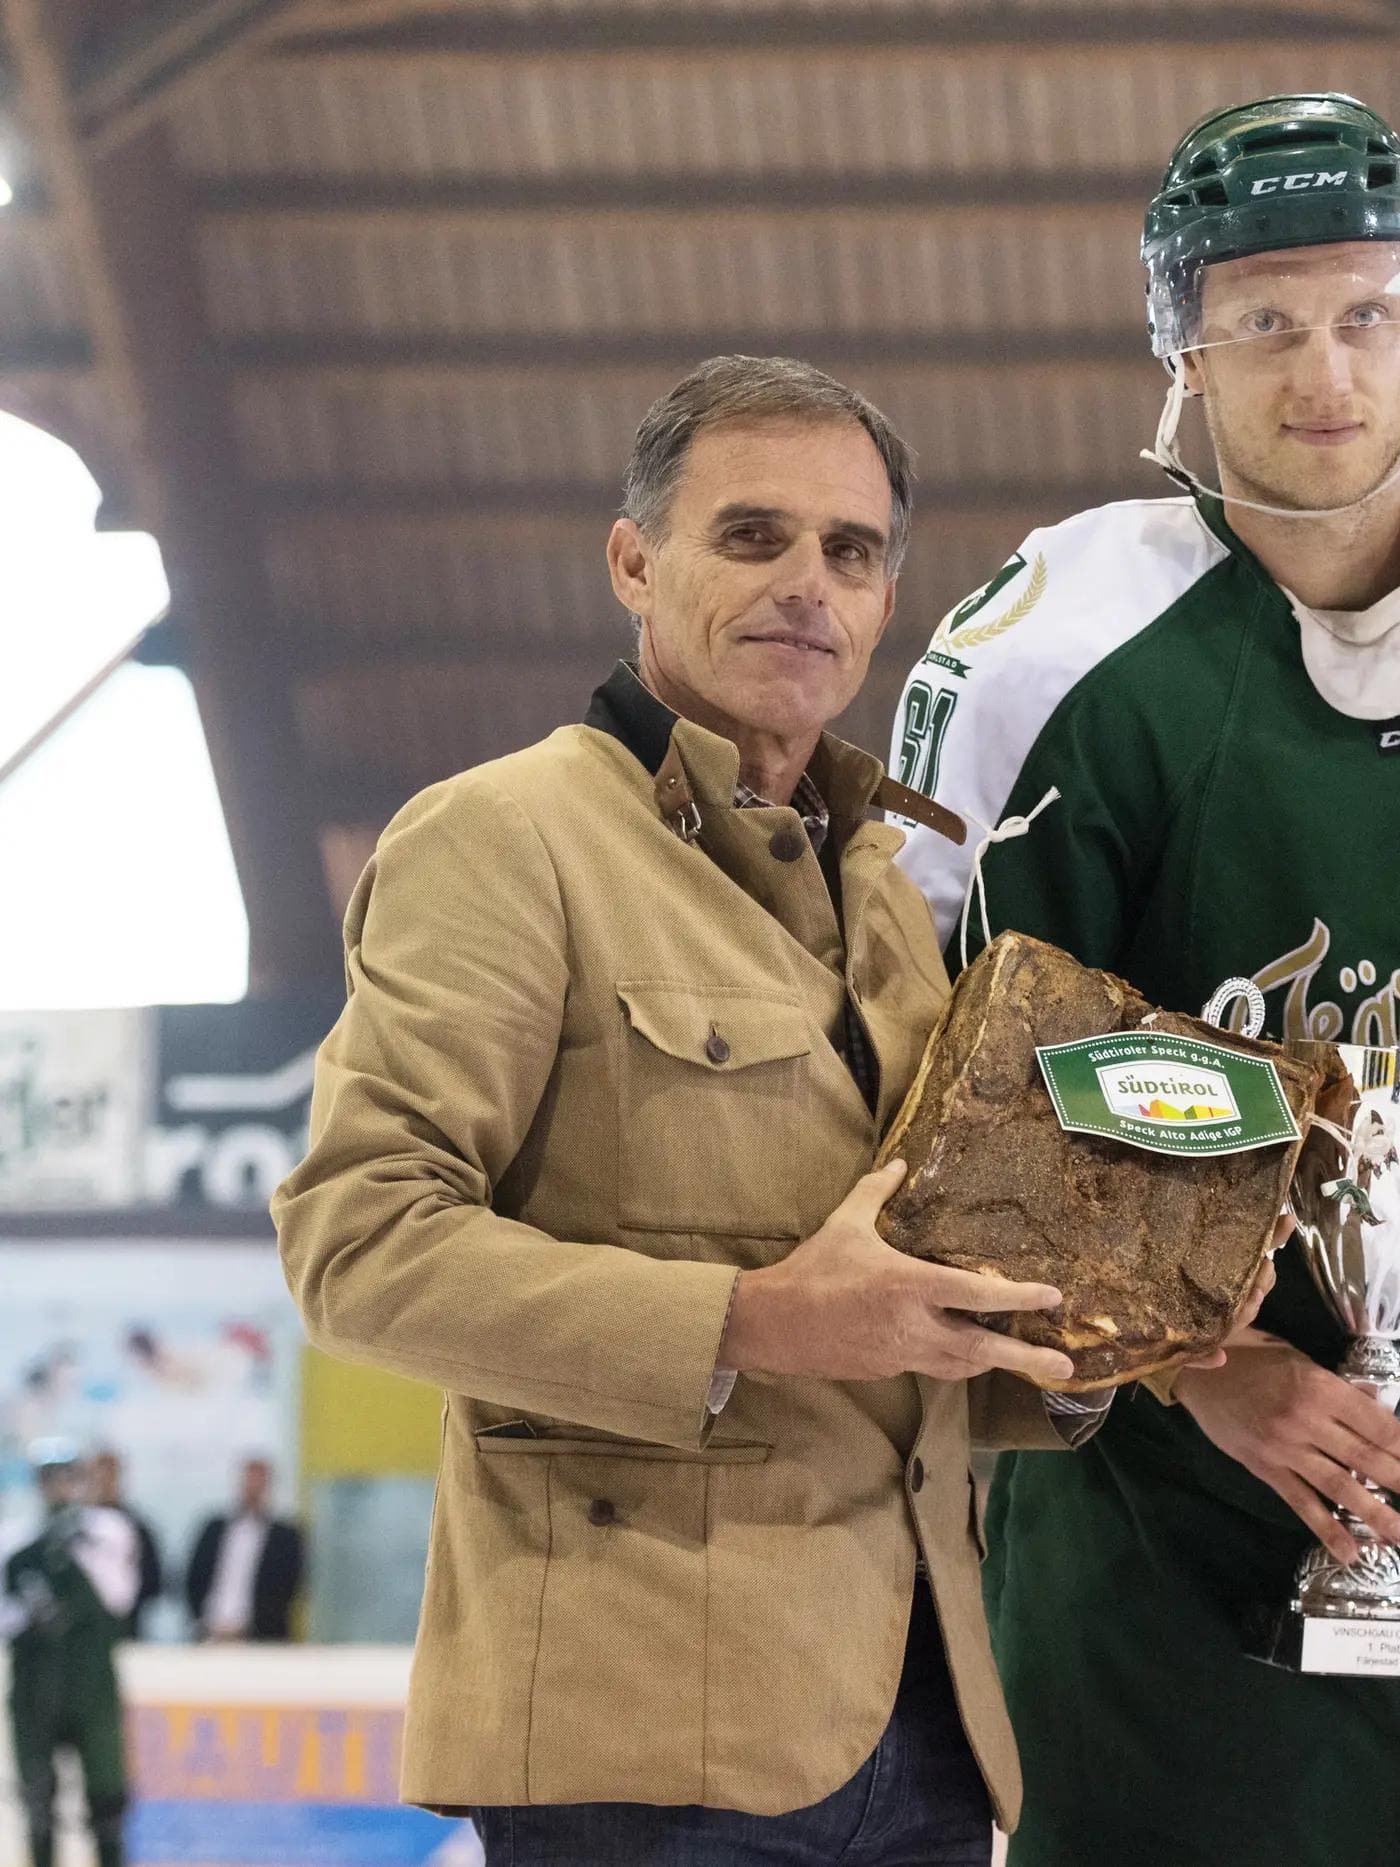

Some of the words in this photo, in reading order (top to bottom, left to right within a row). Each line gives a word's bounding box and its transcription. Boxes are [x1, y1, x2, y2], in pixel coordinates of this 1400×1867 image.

[1250, 170, 1349, 196] CCM
[1087, 1044, 1148, 1063] Südtiroler
[1151, 1044, 1187, 1058] Speck
[1190, 1052, 1226, 1069] g.g.A.
[1119, 1119, 1156, 1137] Speck
[1156, 1129, 1187, 1141] Alto
[1189, 1130, 1223, 1142] Adige
[1224, 1125, 1243, 1138] IGP
[146, 1122, 314, 1207] ro
[1332, 1627, 1394, 1639] VINSCHGAU
